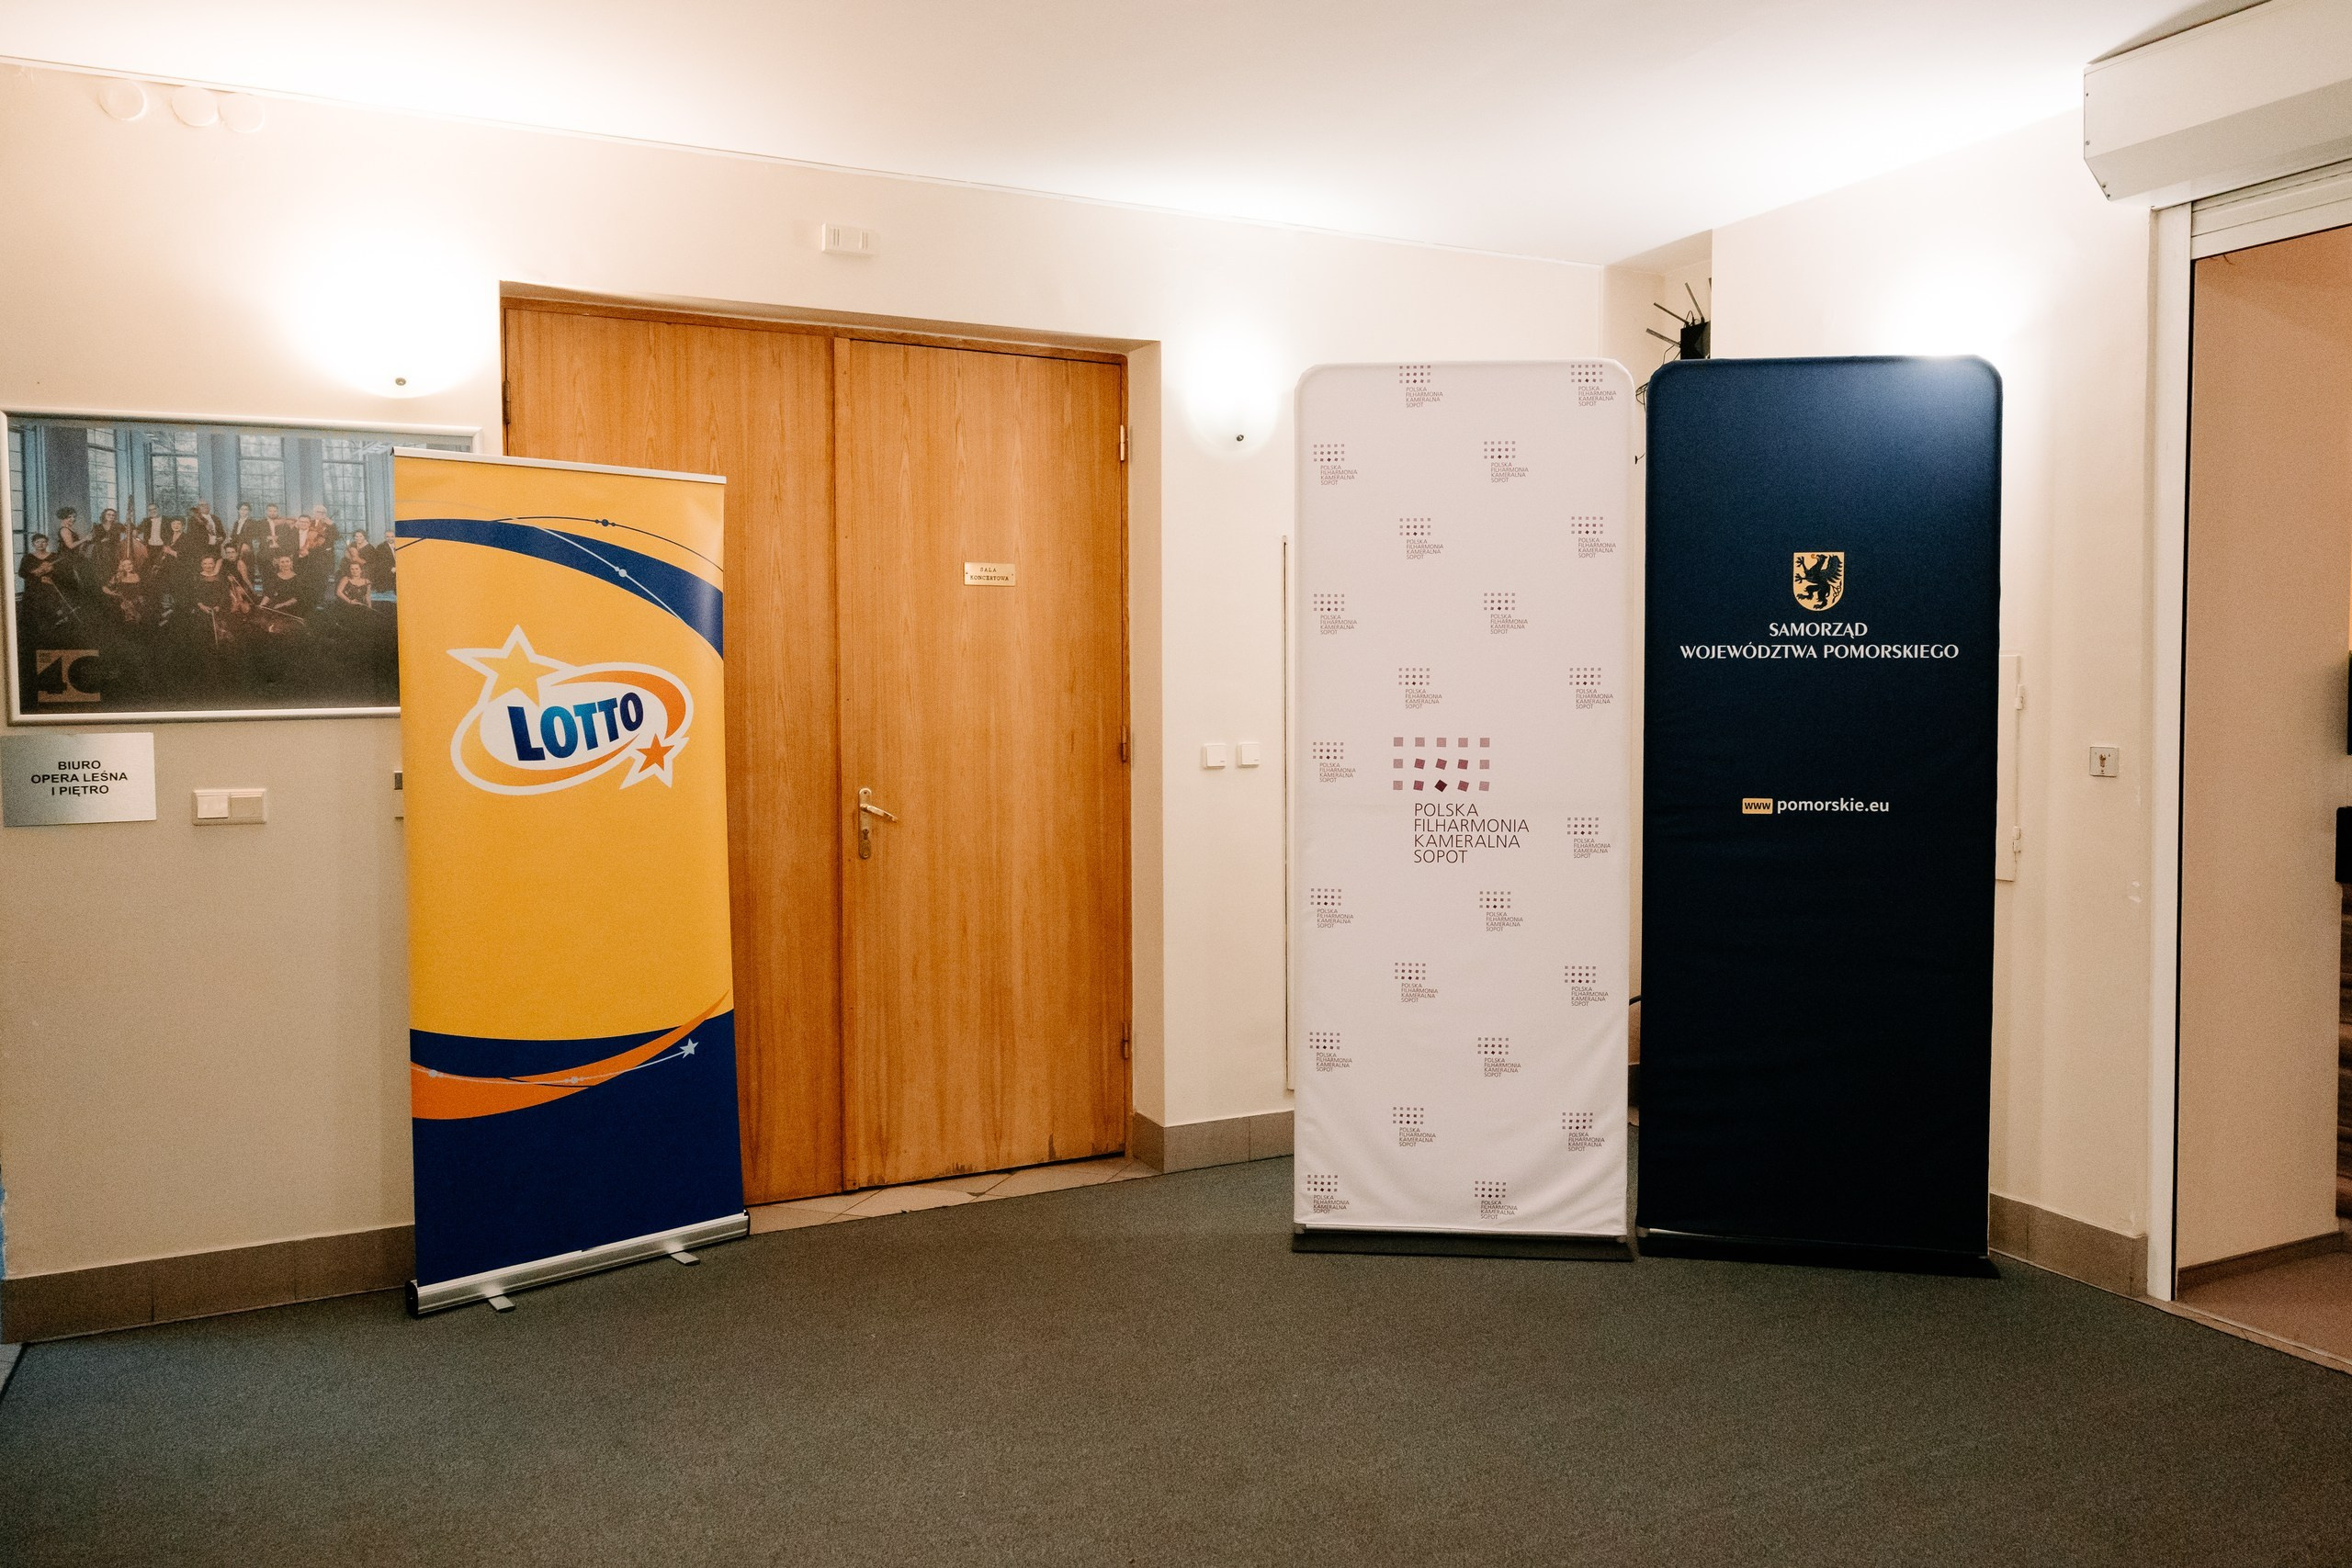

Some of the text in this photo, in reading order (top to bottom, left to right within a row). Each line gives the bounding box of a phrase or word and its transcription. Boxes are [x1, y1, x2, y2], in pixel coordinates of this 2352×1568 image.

[1769, 622, 1868, 639] SAMORZĄD
[1679, 641, 1960, 660] WOJEWÓDZTWA POMORSKIEGO
[507, 692, 644, 761] LOTTO
[58, 760, 101, 771] BIURO
[30, 770, 128, 784] OPERA LEŚNA
[51, 784, 109, 796] I PIĘTRO
[1413, 802, 1479, 818] POLSKA
[1744, 797, 1890, 814] www pomorskie.eu
[1413, 818, 1530, 833] FILHARMONIA
[1413, 834, 1521, 849] KAMERALNA
[1413, 849, 1468, 864] SOPOT
